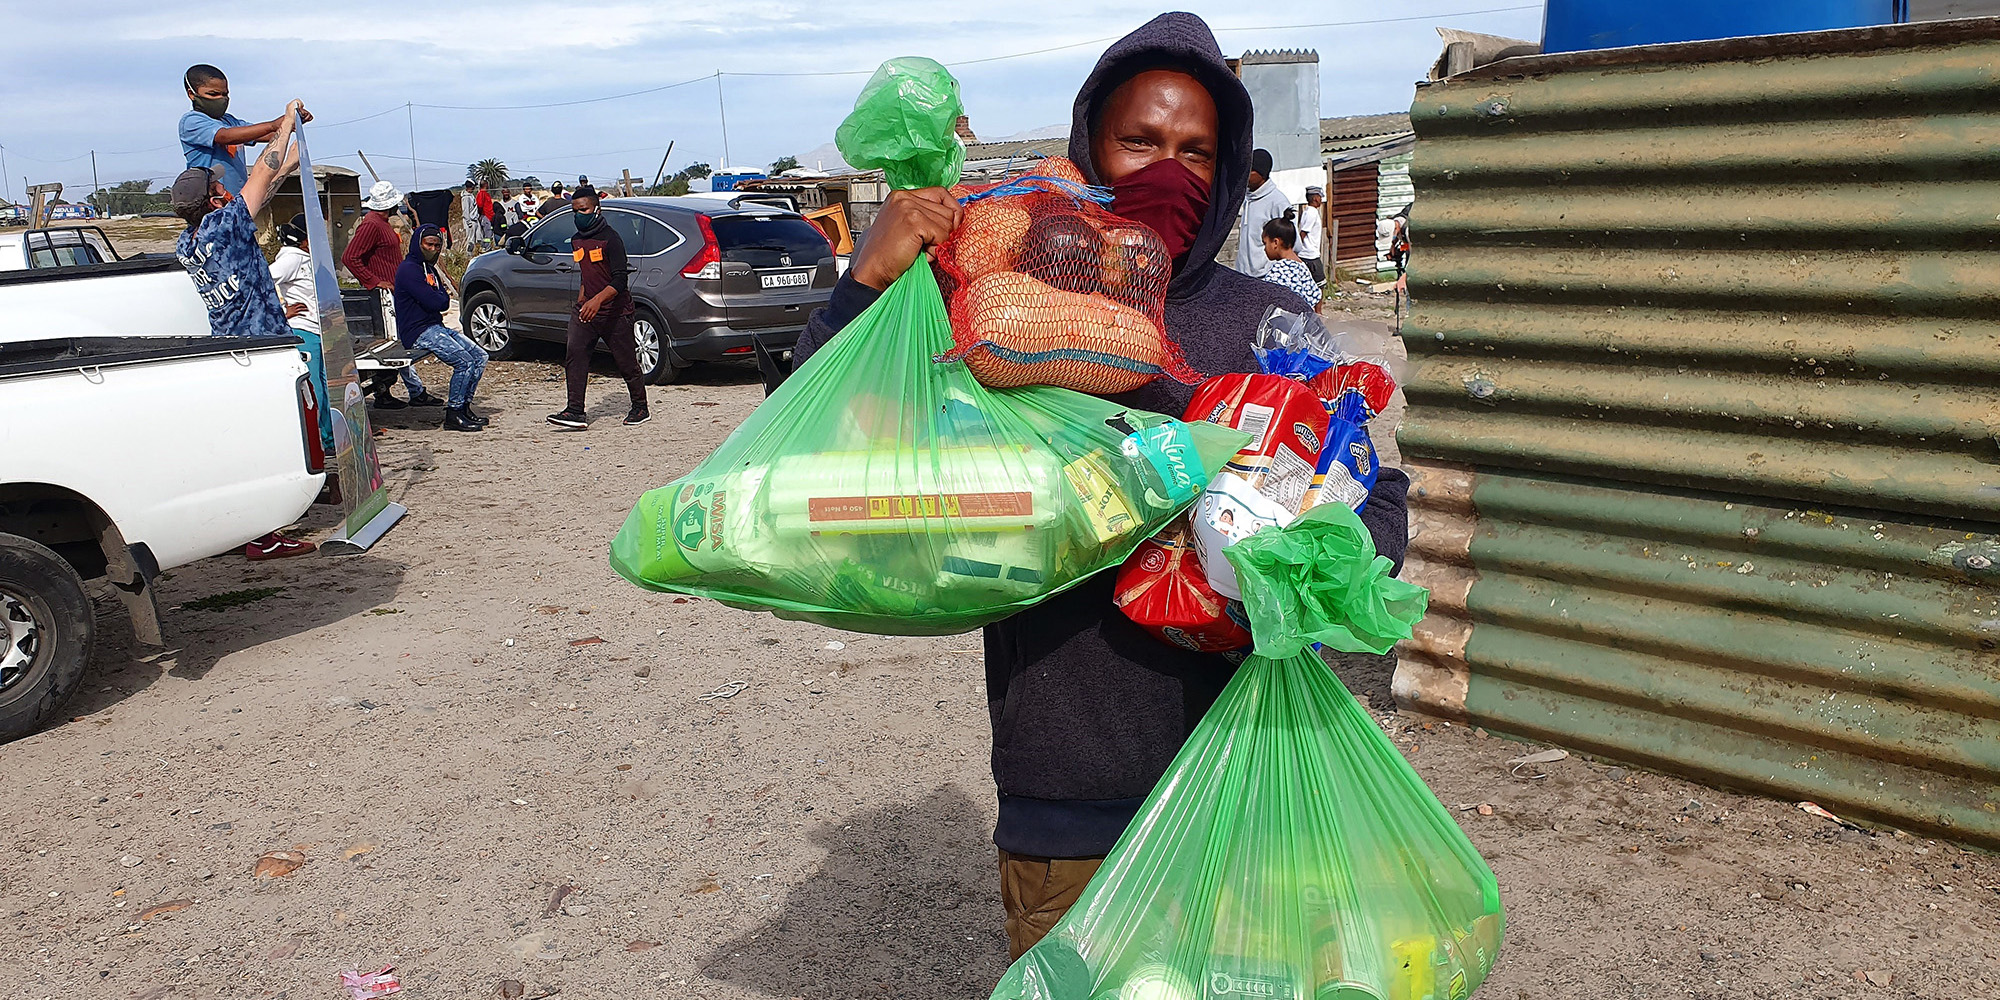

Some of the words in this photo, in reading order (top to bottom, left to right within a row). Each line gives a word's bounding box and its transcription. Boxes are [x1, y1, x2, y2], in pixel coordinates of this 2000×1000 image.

[763, 276, 775, 287] CA
[776, 274, 807, 286] 960-088
[1150, 424, 1191, 489] Nina
[655, 504, 664, 535] MAIZE
[710, 490, 726, 552] IWISA
